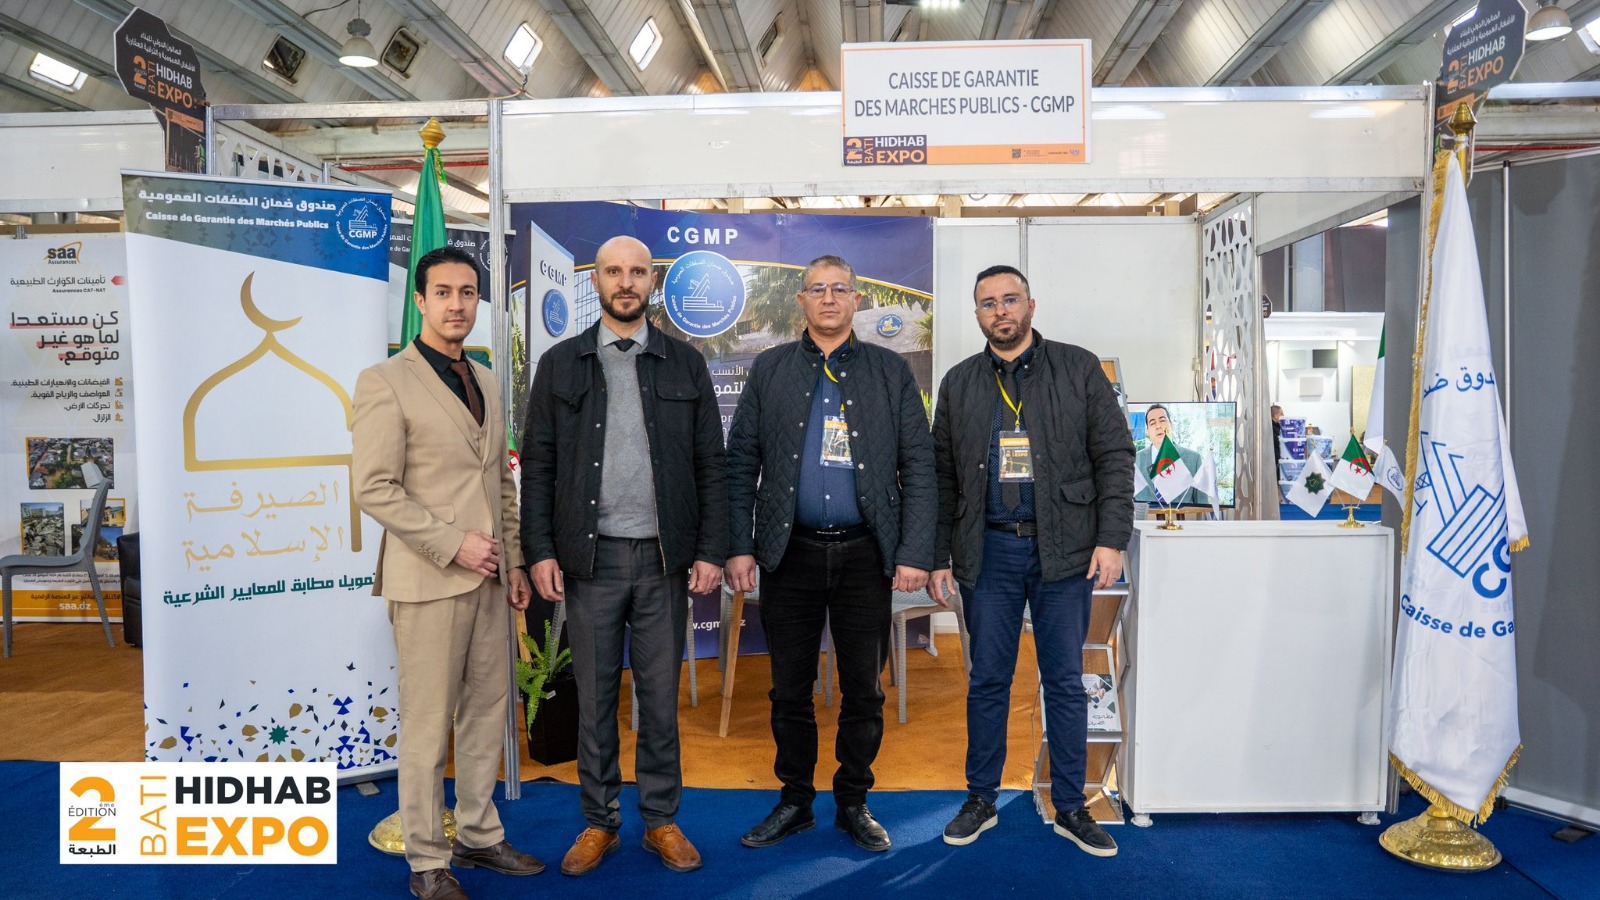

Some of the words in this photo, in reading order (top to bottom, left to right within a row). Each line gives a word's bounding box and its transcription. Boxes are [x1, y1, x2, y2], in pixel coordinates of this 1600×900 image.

[1468, 36, 1506, 65] HIDHAB
[134, 55, 146, 86] 2
[148, 60, 156, 94] BATI
[156, 63, 193, 89] HIDHAB
[1447, 60, 1460, 90] 2
[1459, 54, 1468, 90] BATI
[1468, 56, 1504, 86] EXPO
[888, 72, 938, 90] CAISSE
[942, 71, 960, 88] DE
[964, 70, 1039, 88] GARANTIE
[158, 81, 193, 108] EXPO
[854, 99, 882, 117] DES
[885, 98, 956, 116] MARCHES
[959, 96, 1020, 114] PUBLICS
[1031, 95, 1075, 113] CGMP
[875, 136, 925, 148] HIDHAB
[864, 138, 874, 164] BATI
[876, 150, 925, 164] EXPO
[138, 190, 202, 204] العمومية
[205, 194, 258, 206] الصفقات
[261, 196, 294, 209] ضمان
[296, 200, 336, 212] صندوق
[146, 211, 178, 221] Caisse
[180, 214, 192, 222] de
[194, 214, 235, 224] Garantie
[237, 216, 254, 225] des
[256, 217, 294, 228] Marchés
[296, 219, 329, 230] Publics
[348, 230, 378, 239] CGMP
[667, 226, 739, 244] CGMP
[454, 240, 476, 248] صندوق
[47, 247, 76, 260] saa
[10, 278, 46, 288] الطبيعية
[47, 277, 76, 288] الكوارث
[78, 274, 106, 286] تأمينات
[11, 312, 88, 326] مستعدا
[92, 310, 119, 330] كن
[682, 317, 701, 330] Garantie
[728, 294, 738, 314] Publics
[38, 330, 68, 349] غير
[73, 334, 94, 348] هو
[99, 329, 120, 344] لما
[60, 347, 120, 366] متوقع.
[711, 364, 744, 378] الأنسب
[78, 378, 110, 386] الفيضانات
[30, 391, 54, 400] القوية.
[56, 390, 78, 399] والرياح
[79, 390, 110, 398] العواصف
[86, 402, 110, 410] تحركات
[184, 480, 340, 523] الصيرفة
[182, 522, 344, 572] الإسلامية
[230, 580, 286, 601] للمعايير
[290, 578, 334, 595] مطابق
[163, 584, 225, 607] الشرعية
[58, 602, 92, 610] saa.dz
[1402, 594, 1453, 634] Caisse
[1459, 622, 1486, 638] de
